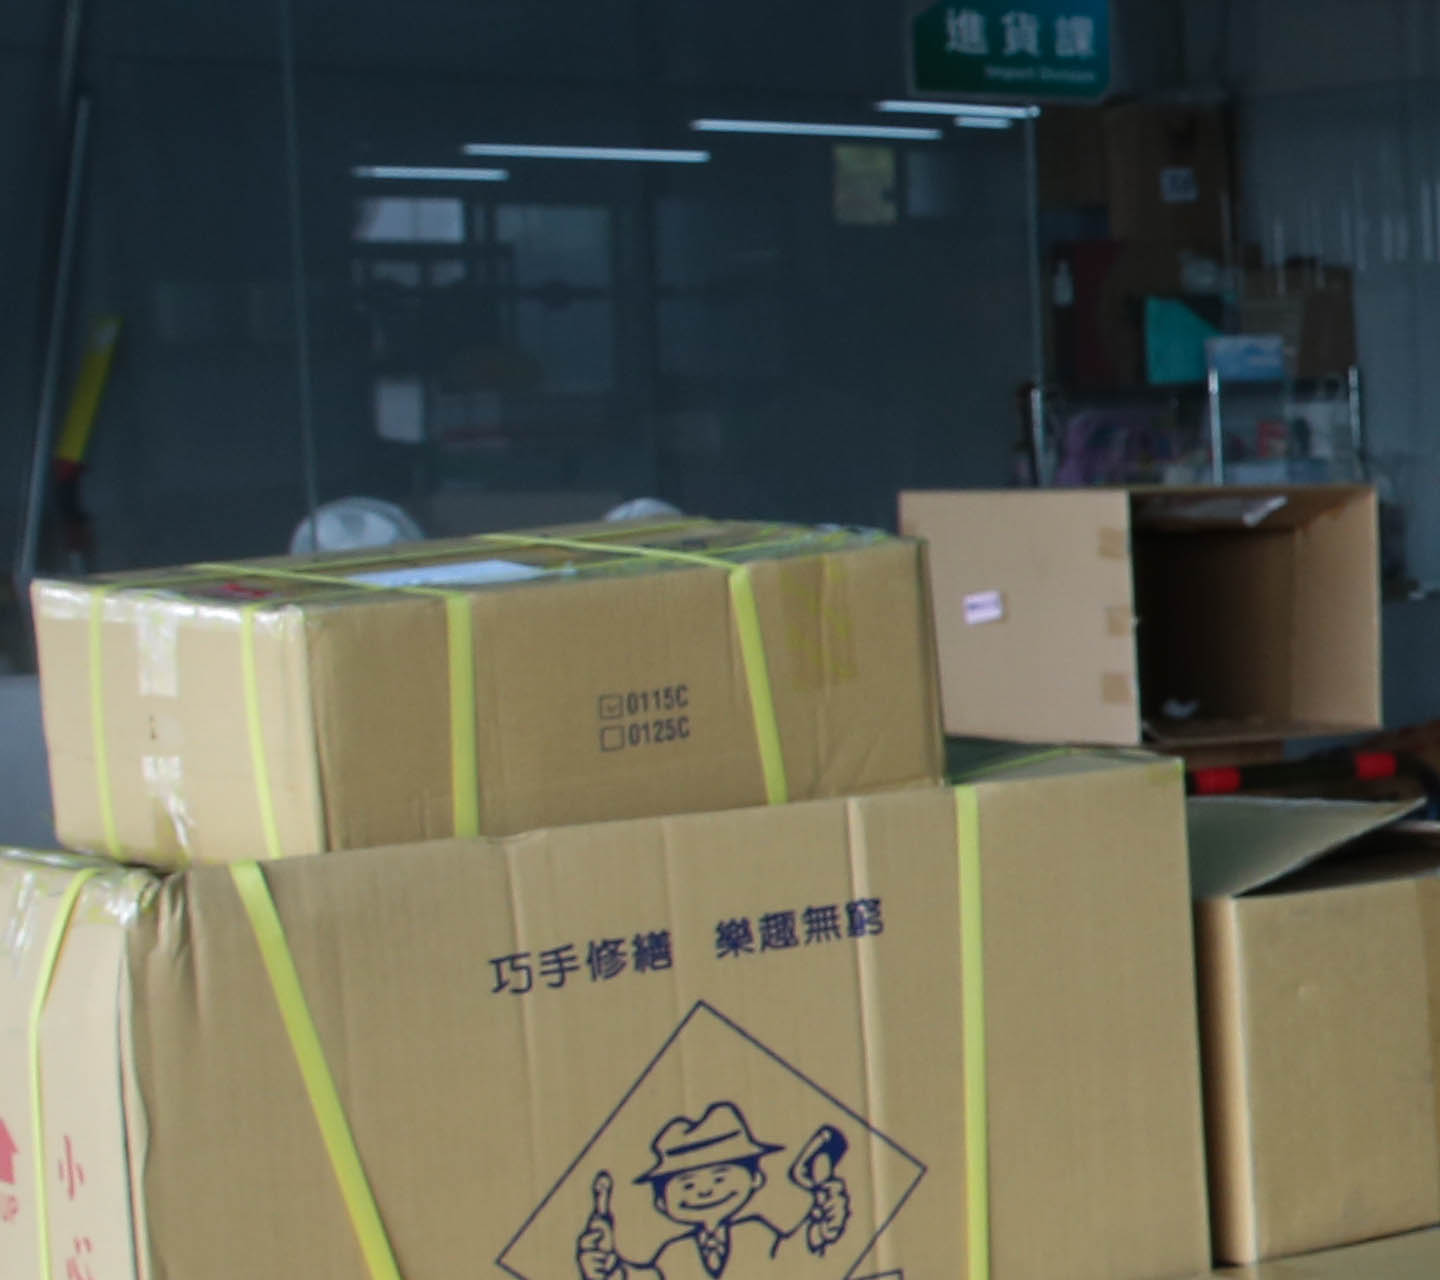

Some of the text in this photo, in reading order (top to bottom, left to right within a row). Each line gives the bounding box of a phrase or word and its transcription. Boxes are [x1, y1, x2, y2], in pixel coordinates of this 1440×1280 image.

[944, 7, 1094, 57] 進貨課
[626, 683, 689, 715] 0115C
[628, 716, 691, 747] 0125C
[487, 896, 885, 995] 巧手修繕 樂趣無窮
